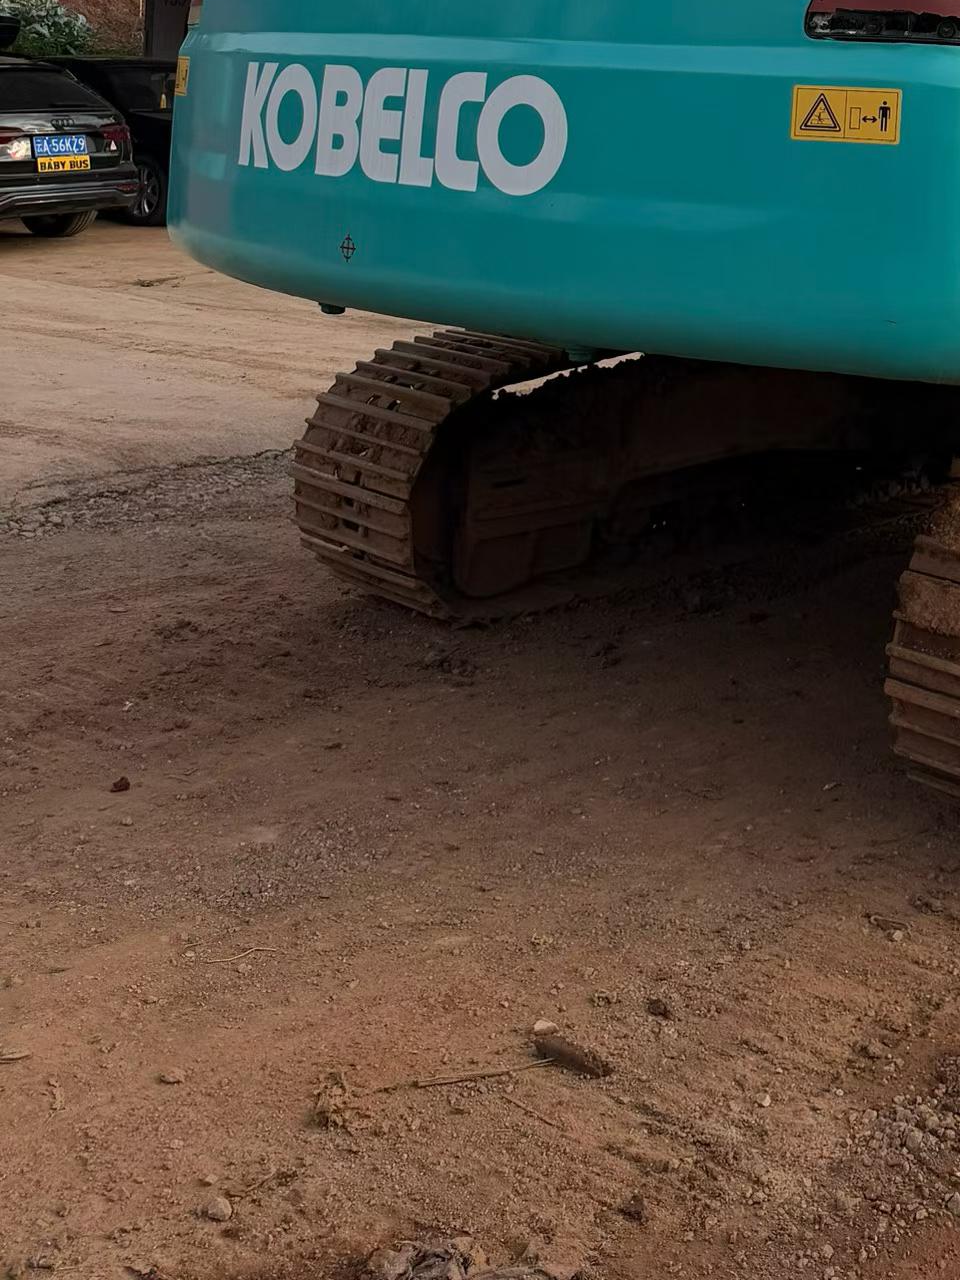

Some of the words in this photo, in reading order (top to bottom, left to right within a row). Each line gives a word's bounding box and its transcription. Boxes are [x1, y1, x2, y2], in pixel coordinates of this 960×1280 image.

[40, 160, 66, 171] BABY
[69, 159, 89, 169] BUS
[238, 61, 569, 196] KOBELCO
